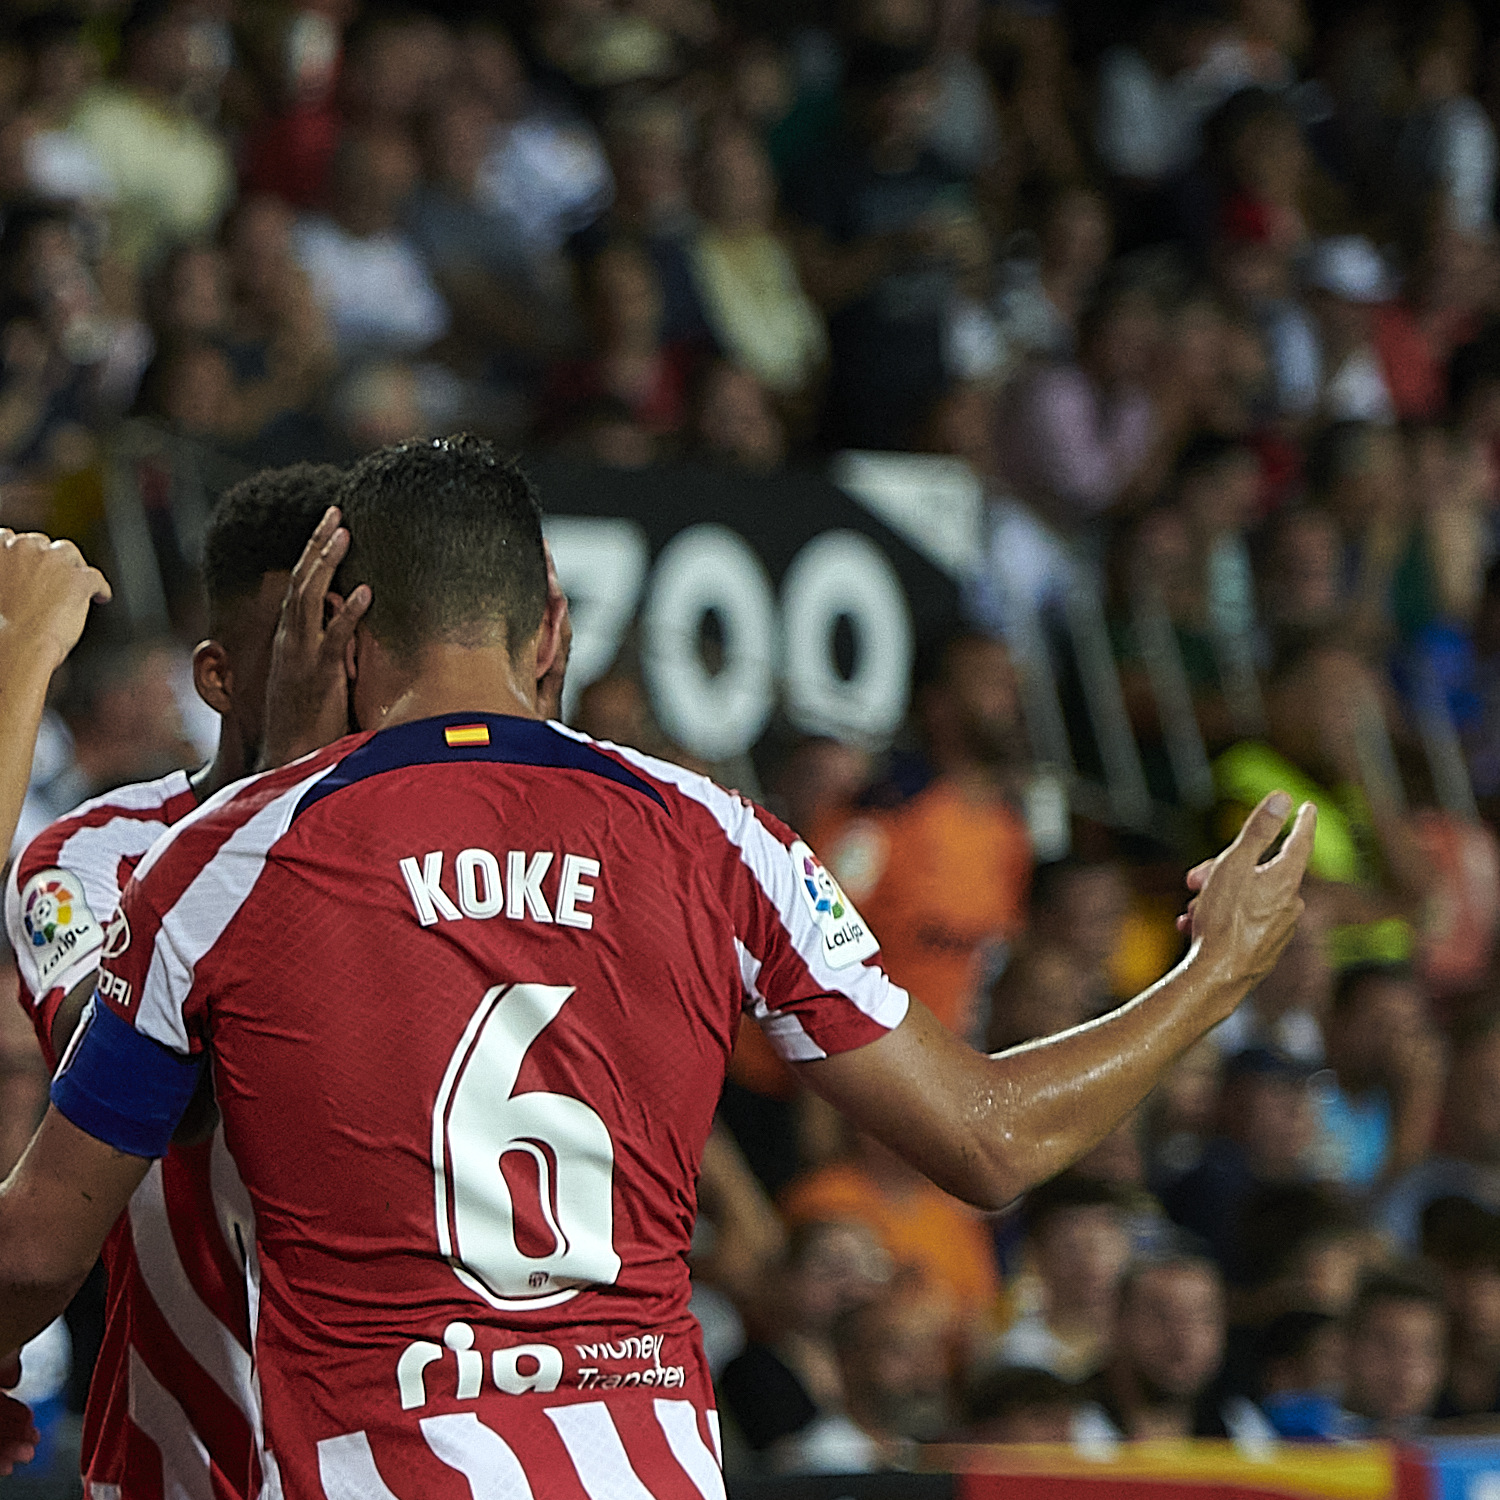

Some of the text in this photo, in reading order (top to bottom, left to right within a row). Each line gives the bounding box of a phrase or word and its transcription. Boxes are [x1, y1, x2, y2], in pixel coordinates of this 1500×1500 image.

[400, 848, 602, 930] KOKE
[431, 982, 622, 1312] 6
[397, 1322, 564, 1411] ria
